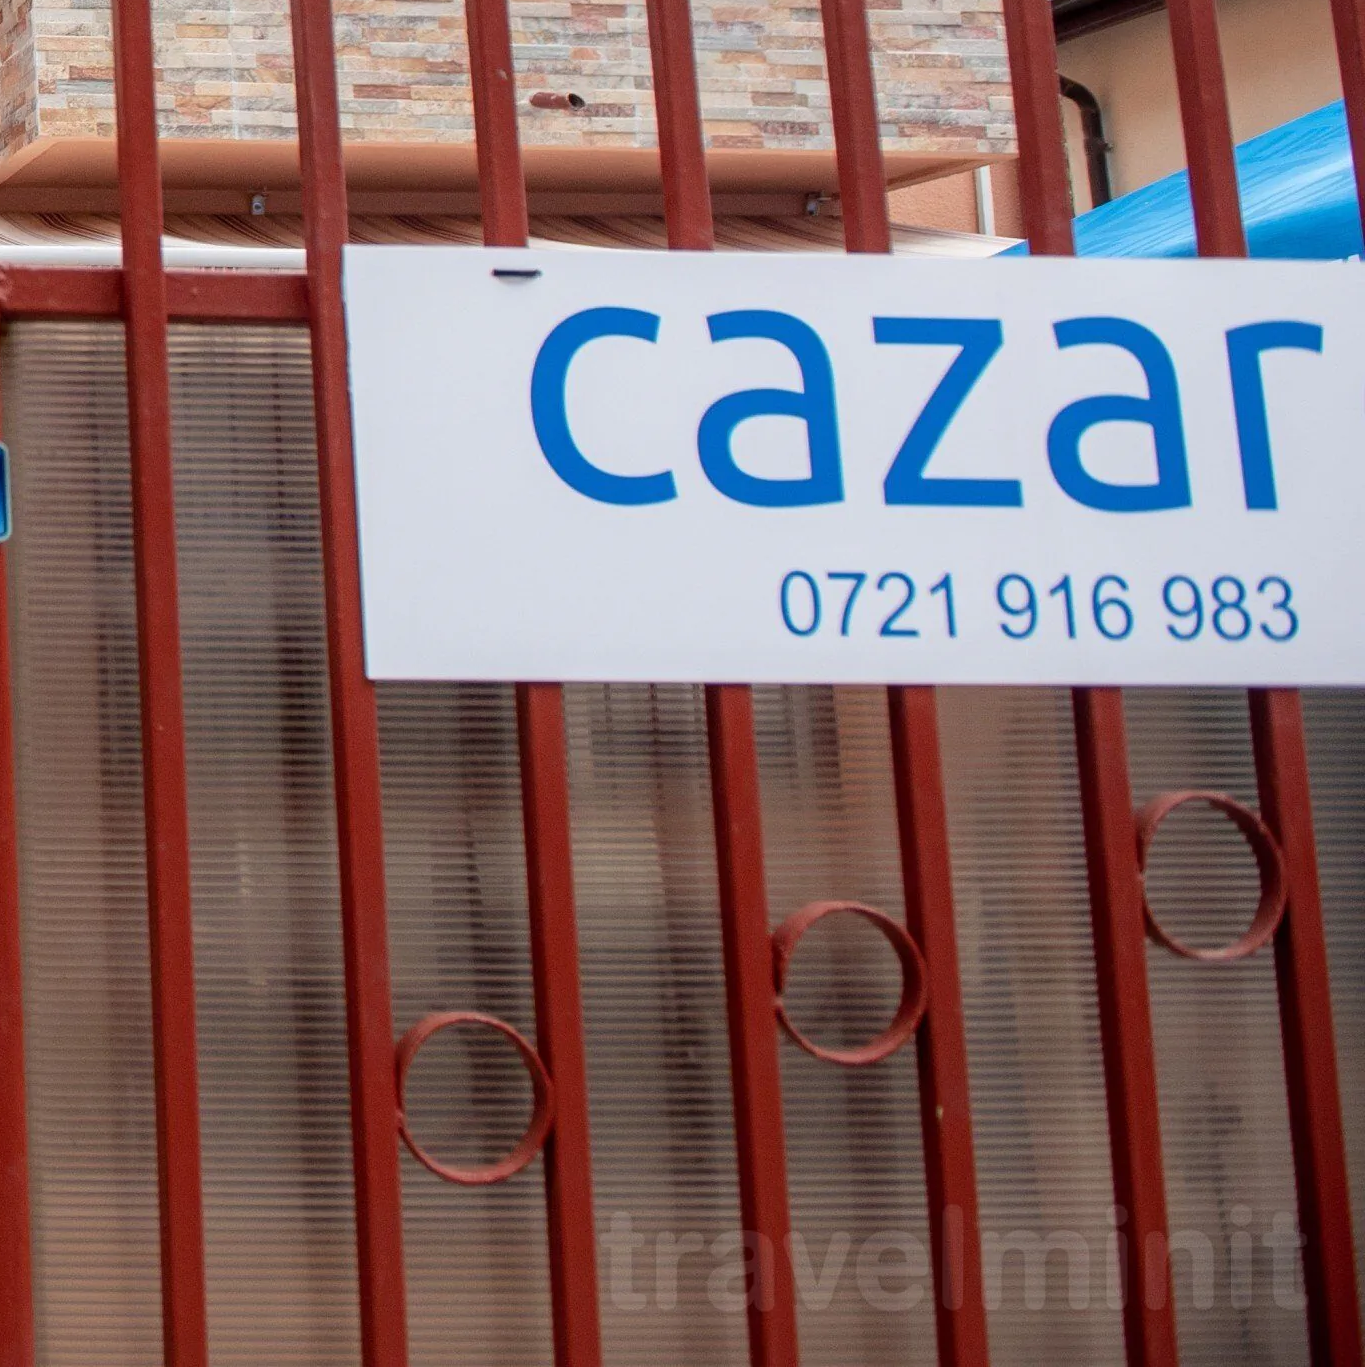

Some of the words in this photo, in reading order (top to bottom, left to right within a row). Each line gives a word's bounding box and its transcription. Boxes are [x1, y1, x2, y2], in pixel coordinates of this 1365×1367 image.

[529, 306, 1324, 512] cazar
[779, 570, 957, 638] 0721
[996, 572, 1133, 640] 916
[1161, 575, 1299, 641] 983
